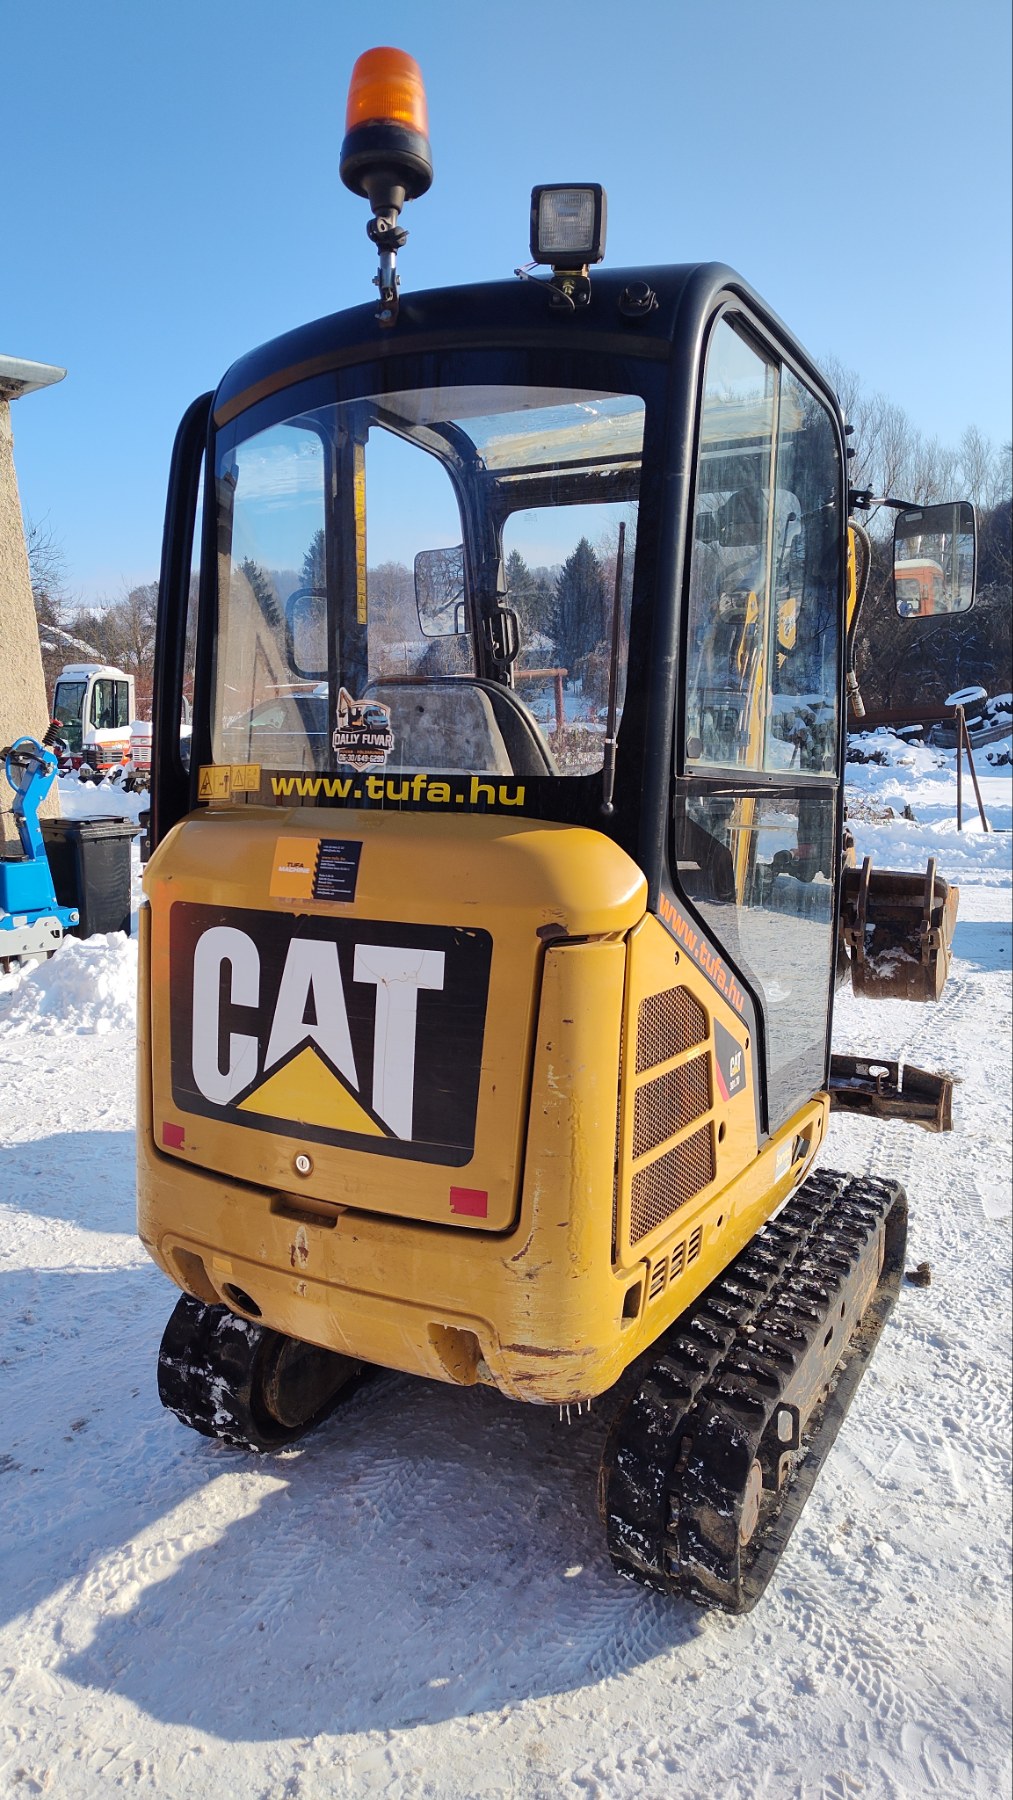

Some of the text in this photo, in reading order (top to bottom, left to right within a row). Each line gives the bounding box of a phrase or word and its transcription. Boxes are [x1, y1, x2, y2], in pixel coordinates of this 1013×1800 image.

[270, 774, 526, 806] www.tufa.hu
[659, 892, 745, 1013] www.tufa.hu
[192, 925, 446, 1142] CAT
[729, 1050, 742, 1078] CAT
